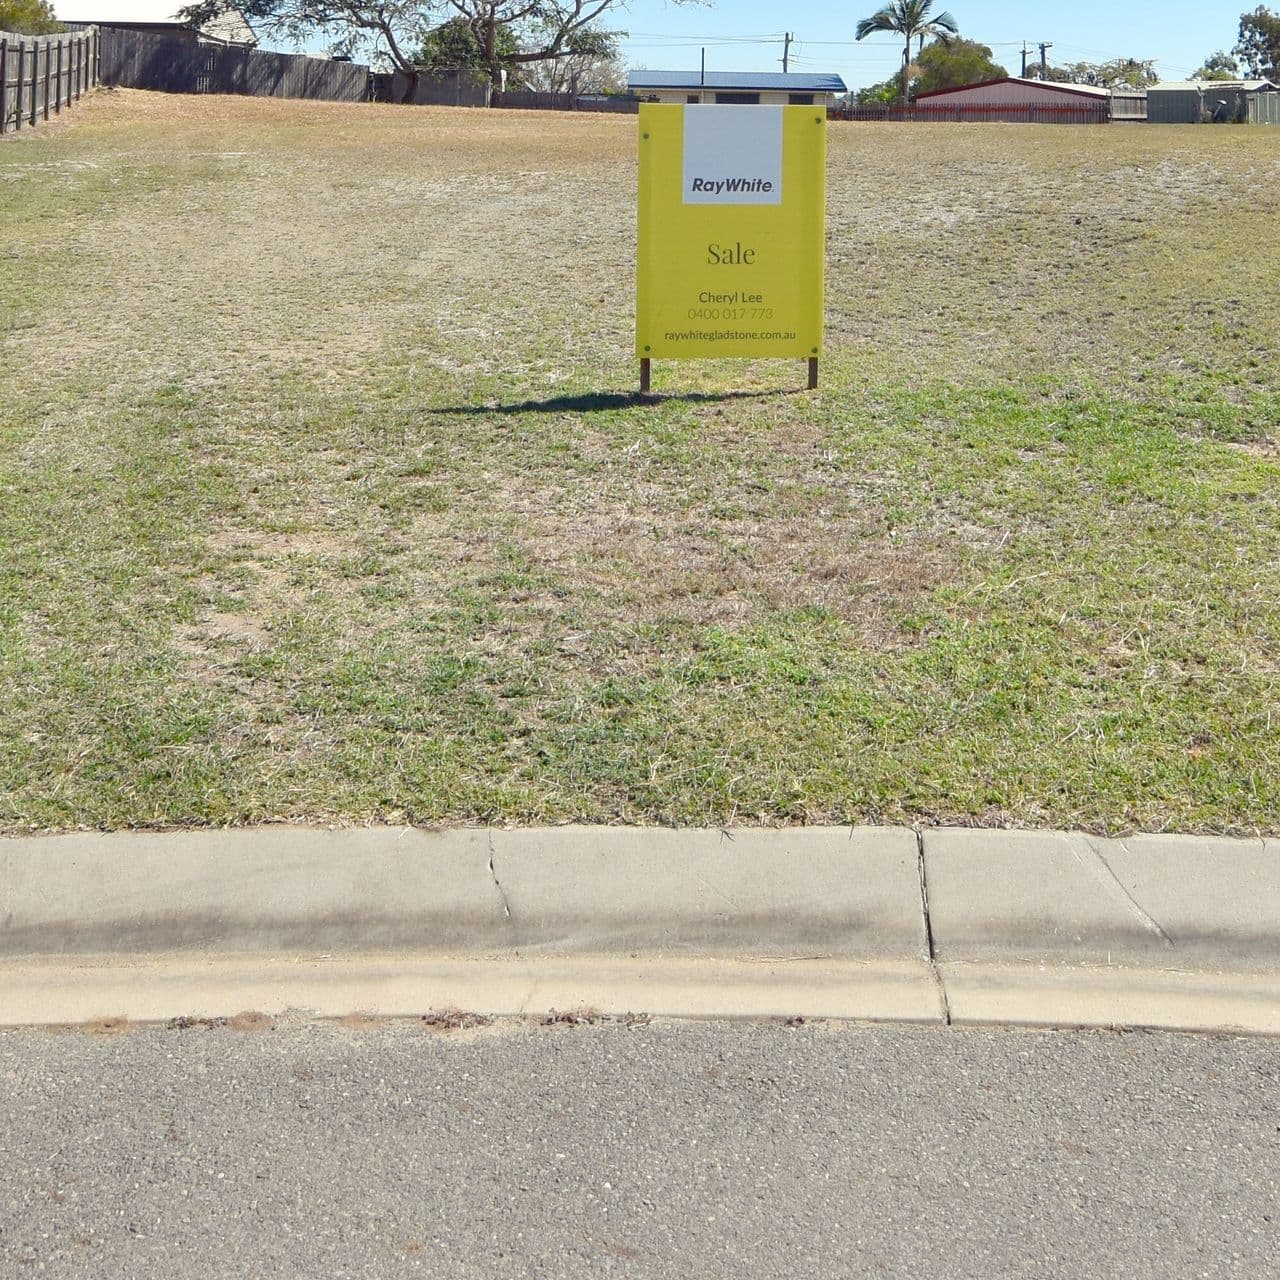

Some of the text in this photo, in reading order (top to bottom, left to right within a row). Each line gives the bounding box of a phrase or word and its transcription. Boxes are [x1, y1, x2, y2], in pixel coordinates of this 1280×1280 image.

[707, 242, 755, 264] Sale
[699, 292, 763, 304] Cheryl Lee
[688, 308, 773, 320] 0400 017 773
[664, 330, 796, 342] raywhitegladstone.com.au
